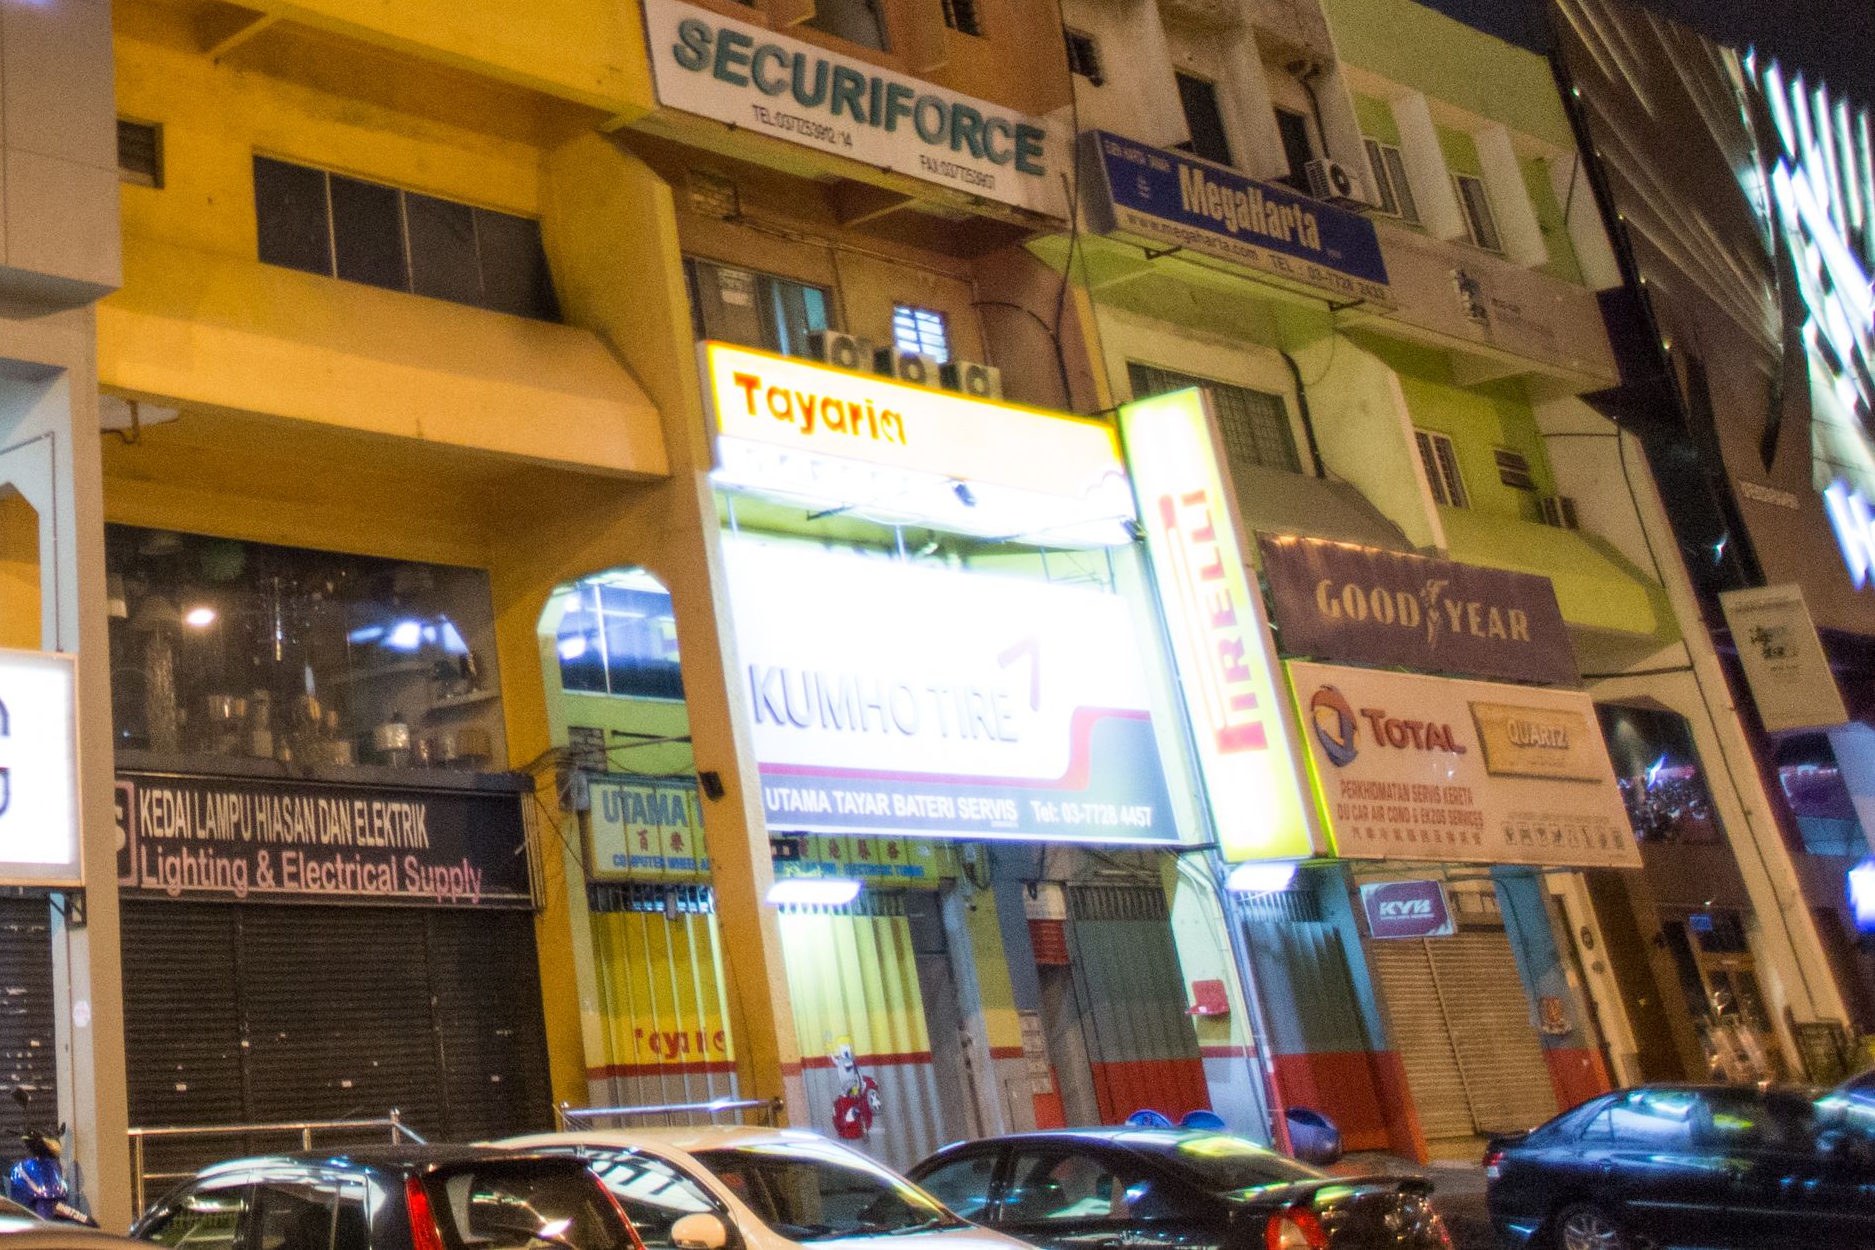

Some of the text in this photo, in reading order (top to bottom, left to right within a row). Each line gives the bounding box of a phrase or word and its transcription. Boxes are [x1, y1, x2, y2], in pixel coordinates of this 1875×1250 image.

[672, 18, 1047, 178] SECURIFORCE
[1178, 163, 1322, 252] MegaHarta
[747, 662, 1020, 744] KUMHO TIRE
[1361, 707, 1467, 756] TOTAL
[1507, 716, 1570, 750] QUARTZ
[139, 789, 430, 850] KEDAI LAMPU HIASAN DAN ELEKTRIK
[602, 790, 688, 828] UTAMA
[765, 786, 830, 815] UTAMA
[832, 790, 890, 817] TAYAR
[893, 792, 956, 819] BATERI
[958, 796, 1018, 823] SERVIS
[1030, 800, 1059, 823] Tel:
[1062, 802, 1118, 826] 03-7728
[141, 845, 483, 905] Lighting & Electrical Supply
[1379, 898, 1432, 916] KYB
